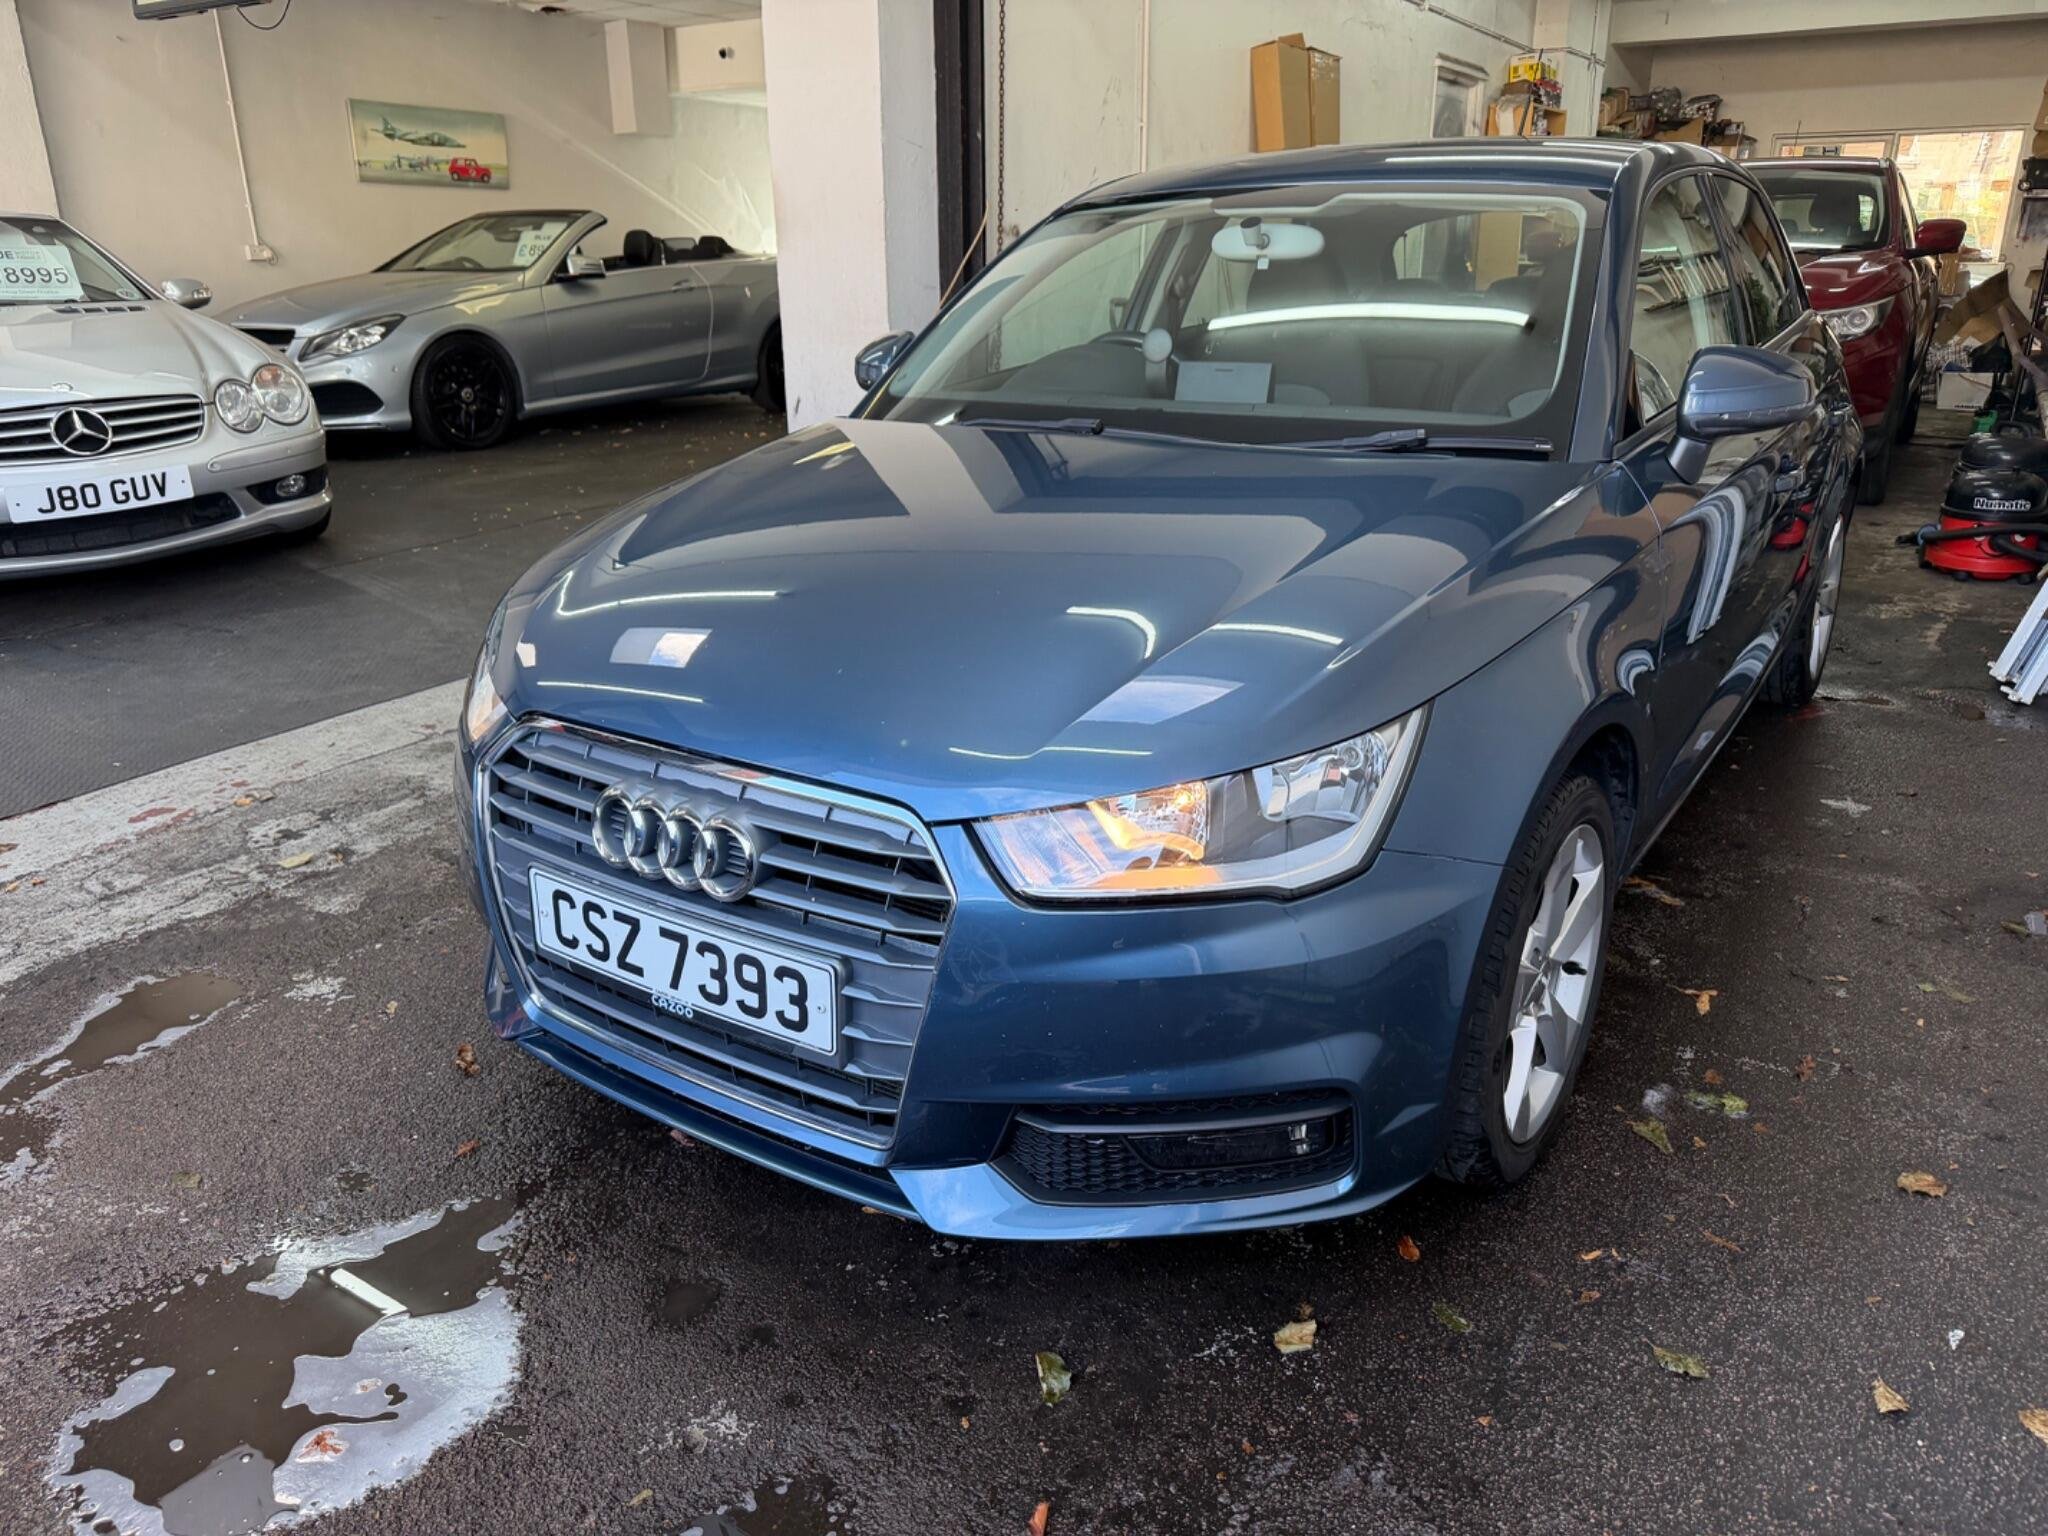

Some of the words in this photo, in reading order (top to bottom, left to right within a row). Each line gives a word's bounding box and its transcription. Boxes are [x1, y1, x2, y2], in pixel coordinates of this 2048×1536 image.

[0, 266, 69, 284] 8995
[37, 482, 102, 514] J80
[109, 471, 168, 505] GUV
[552, 889, 645, 978] CSZ
[659, 926, 810, 1033] 7393
